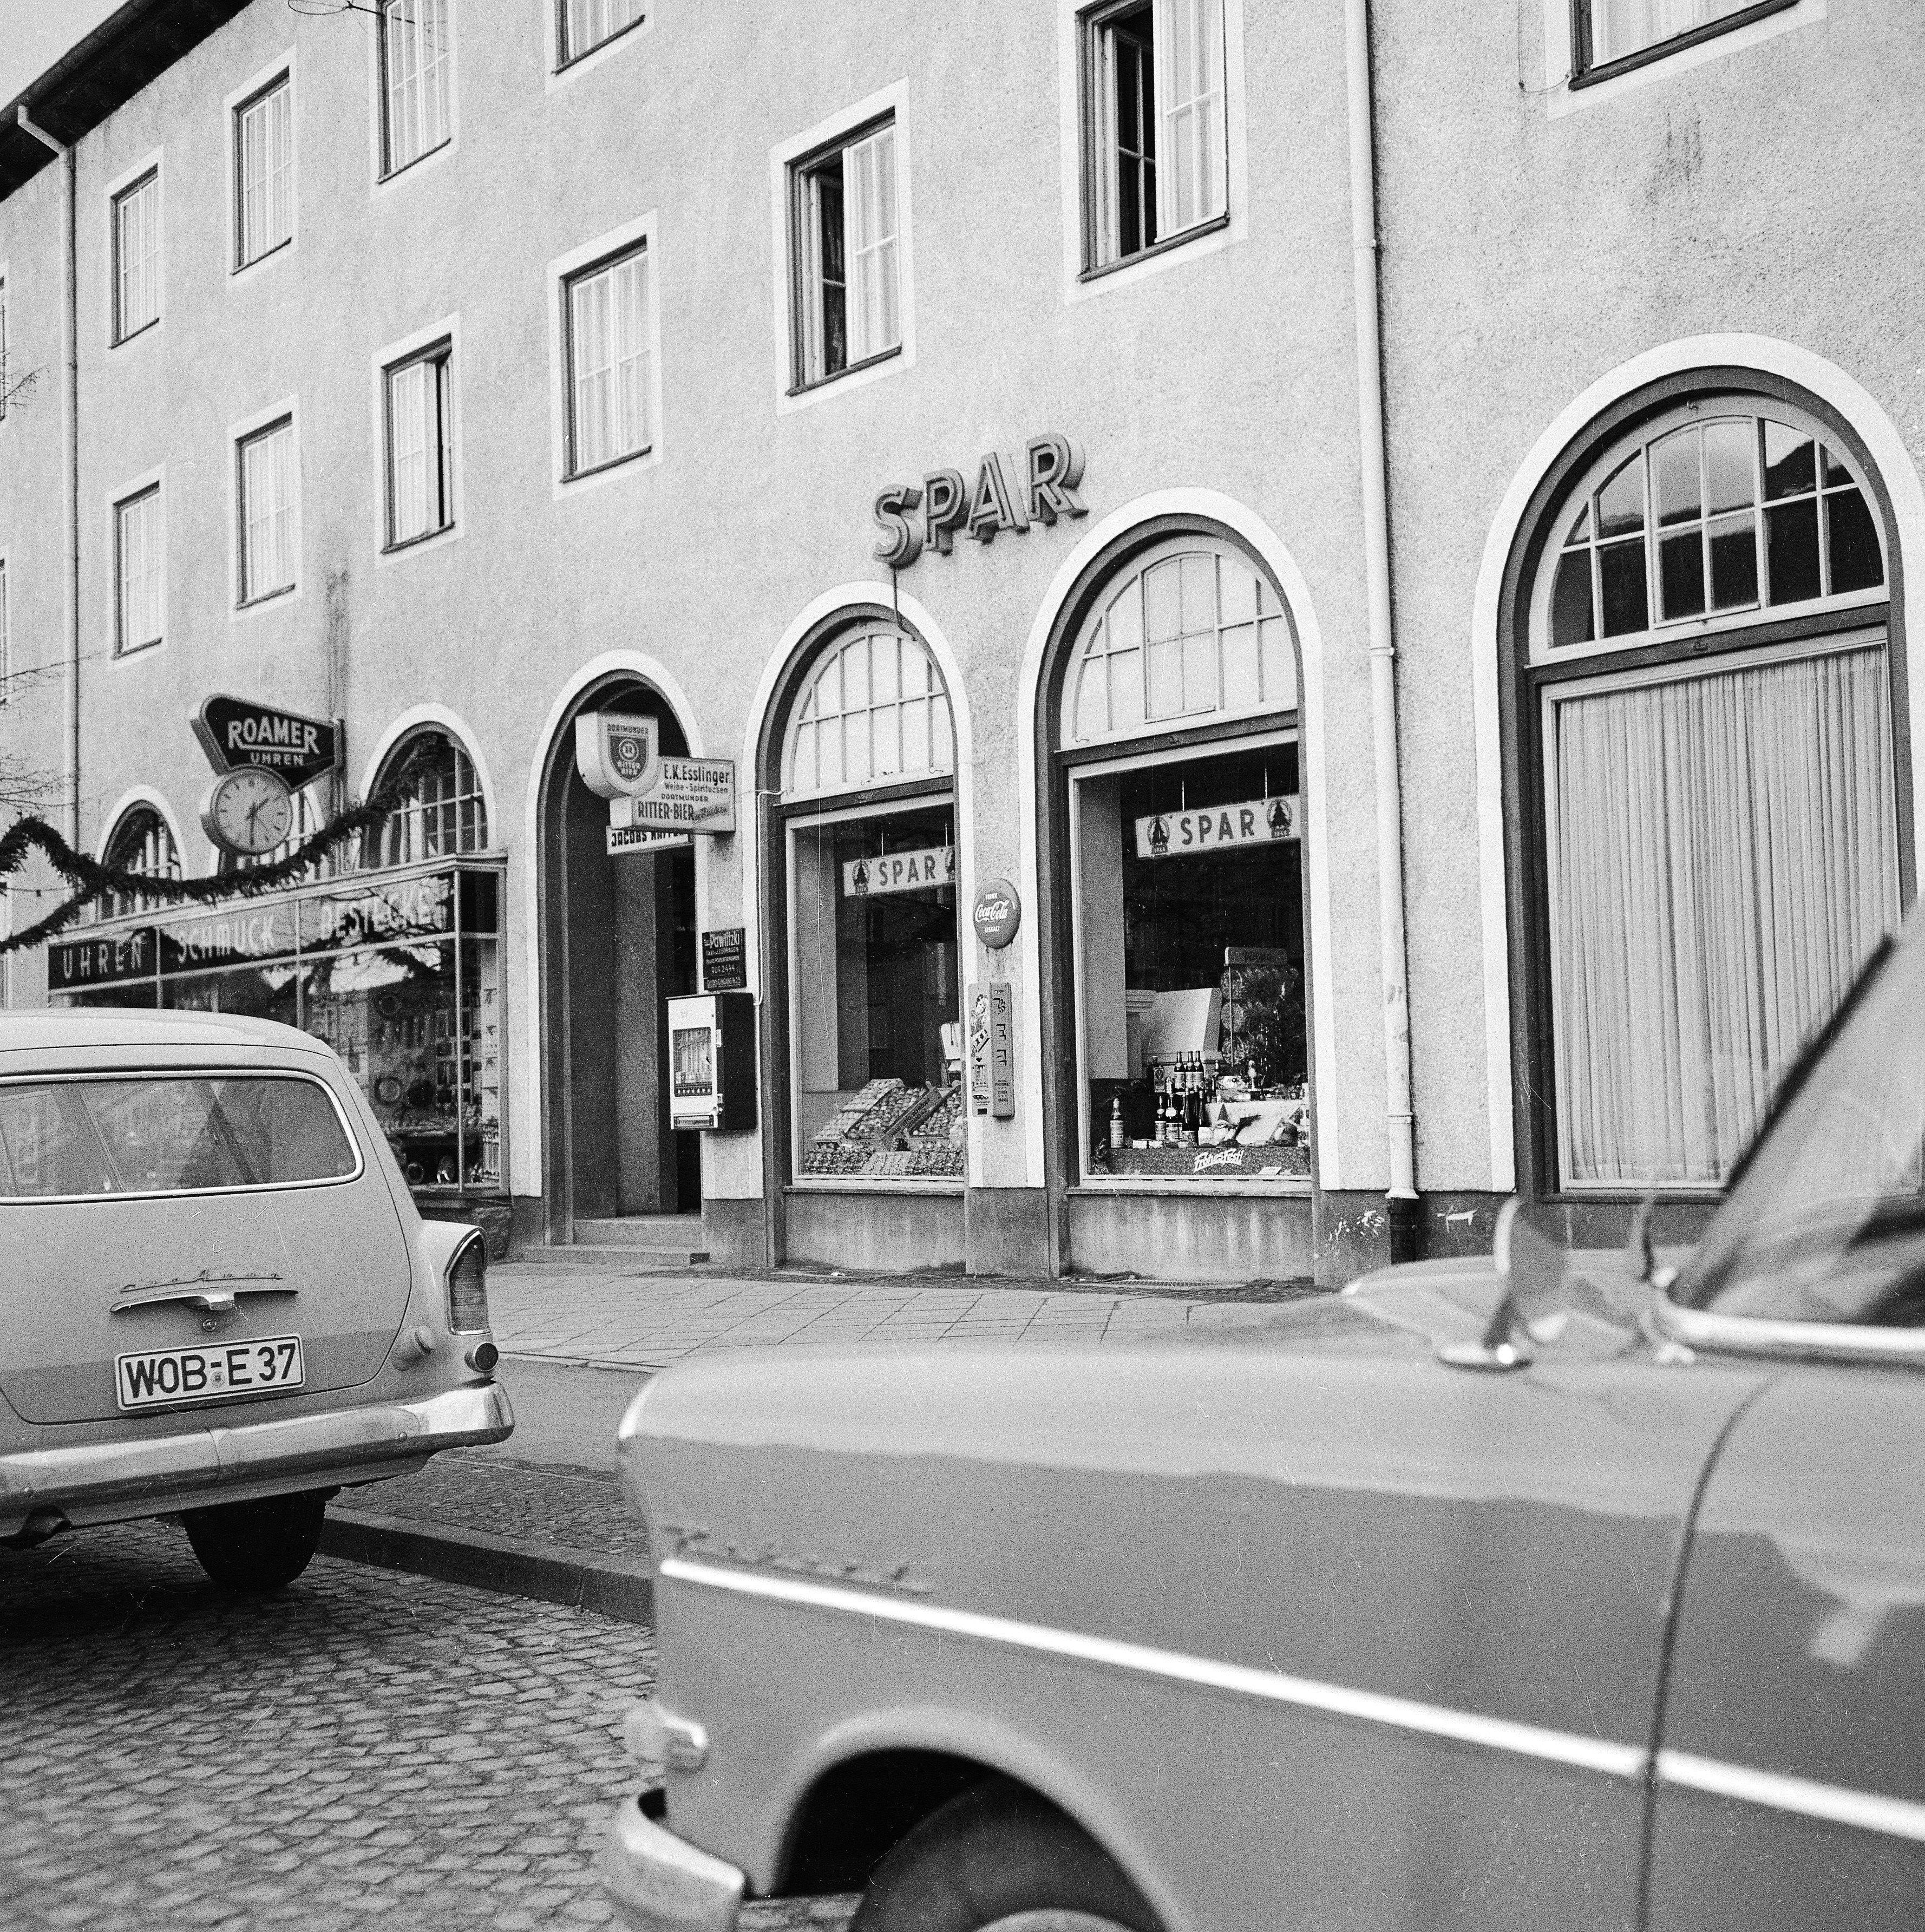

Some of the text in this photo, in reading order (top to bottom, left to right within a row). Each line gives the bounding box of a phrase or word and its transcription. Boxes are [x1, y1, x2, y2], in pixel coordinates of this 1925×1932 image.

[872, 433, 1088, 569] SPAR
[228, 716, 320, 755] ROAMER
[250, 751, 304, 767] UHREN
[661, 793, 709, 803] DORTMUNDER
[665, 781, 684, 791] Weine
[611, 830, 647, 847] JACOBS
[1180, 808, 1255, 846] SPAR
[879, 854, 936, 887] SPAR
[63, 885, 432, 979] UHREN SCHMUCK BESTECKE
[985, 925, 1000, 933] EISKALT
[257, 1343, 296, 1381] 37
